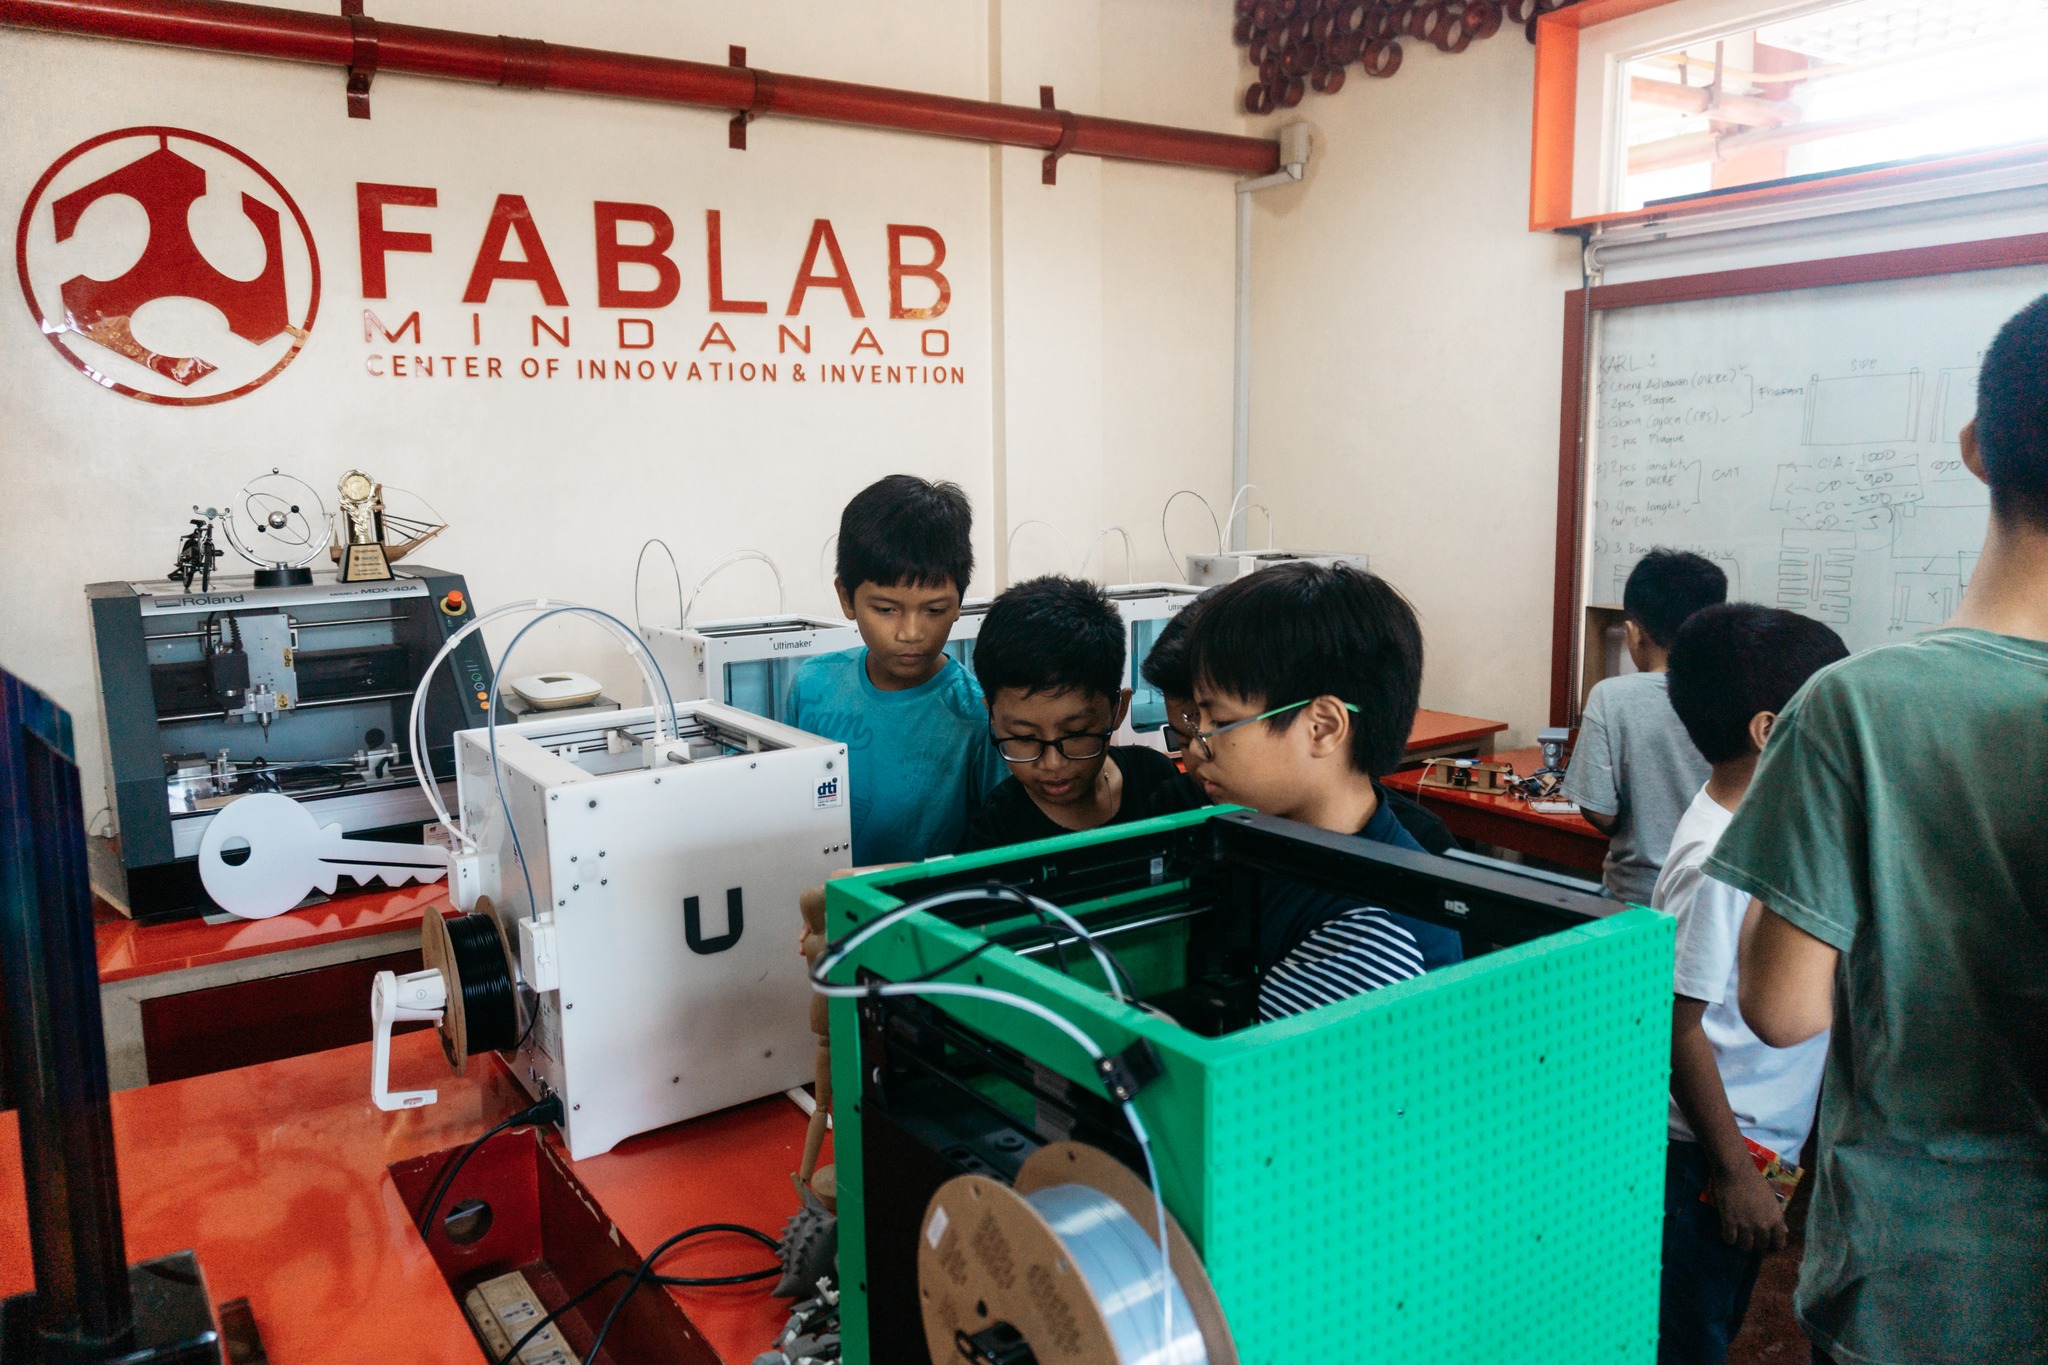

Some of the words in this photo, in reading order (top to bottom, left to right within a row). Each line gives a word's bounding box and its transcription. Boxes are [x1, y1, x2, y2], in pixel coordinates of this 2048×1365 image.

[356, 182, 951, 320] FABLAB
[363, 308, 950, 357] MINDANAO
[366, 354, 503, 379] CENTER
[521, 357, 560, 379] OF
[577, 359, 778, 382] INNOVATION
[792, 363, 807, 382] &
[821, 364, 965, 384] INVENTION
[181, 593, 245, 607] Roland
[361, 585, 418, 594] MDX-40A
[773, 640, 812, 651] Ultimaker
[817, 777, 838, 796] dti
[683, 886, 744, 956] U
